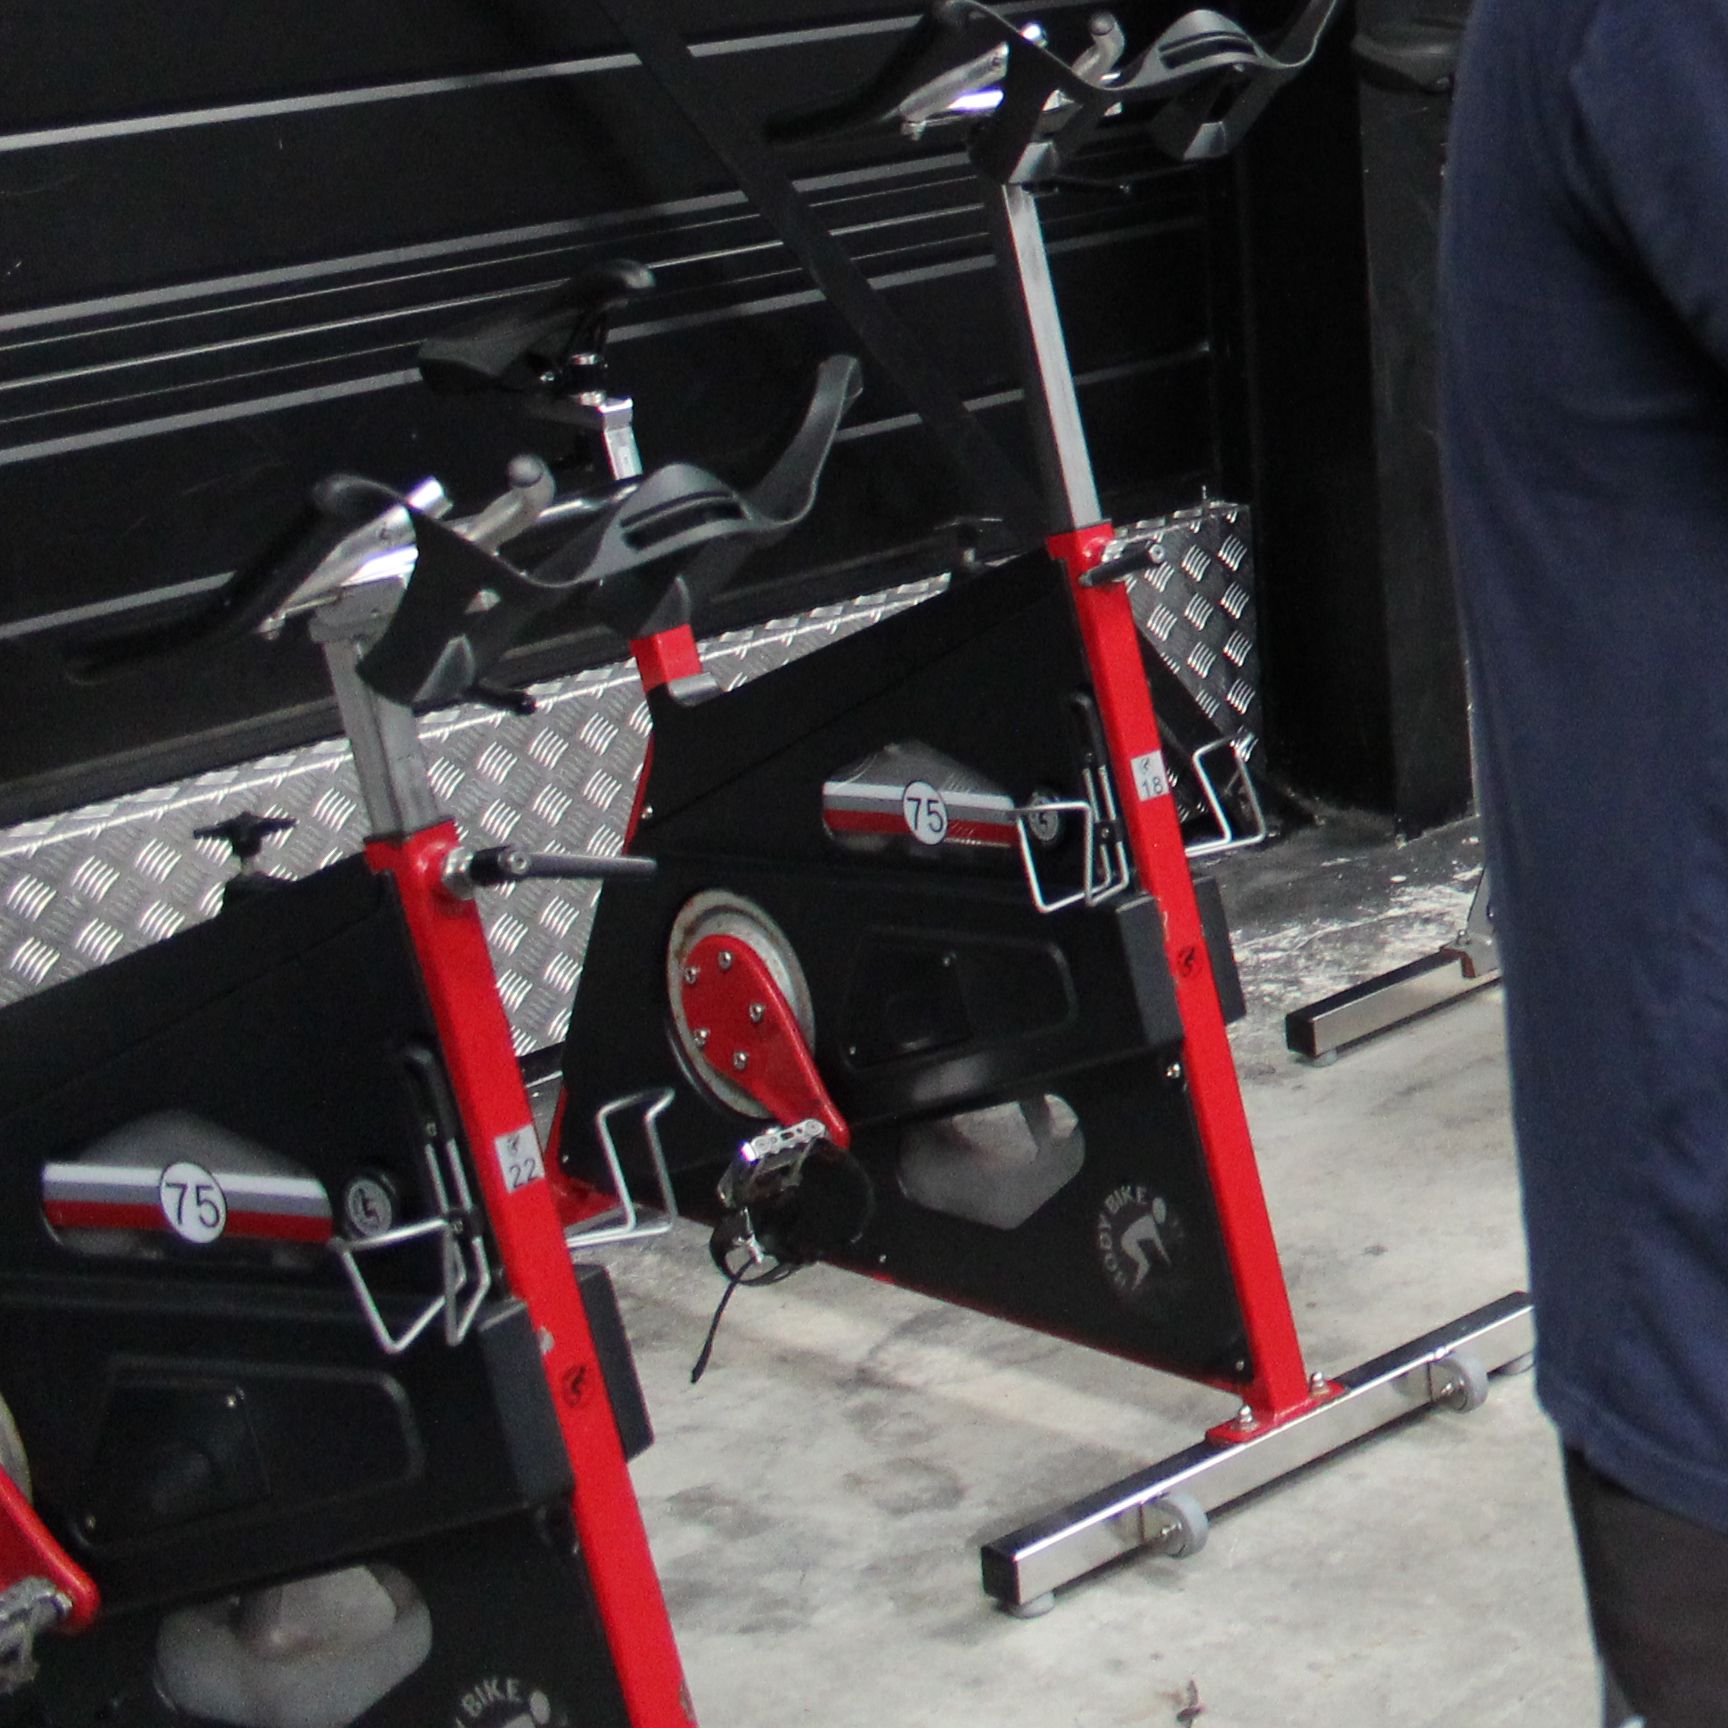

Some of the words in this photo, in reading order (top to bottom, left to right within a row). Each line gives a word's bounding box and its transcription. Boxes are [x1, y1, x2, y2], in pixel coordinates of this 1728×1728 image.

[1142, 776, 1164, 797] 18
[906, 797, 943, 834] 75
[509, 1158, 538, 1189] 22
[164, 1182, 221, 1229] 75
[1105, 1185, 1149, 1214] BIKE
[461, 1676, 525, 1717] BIKE
